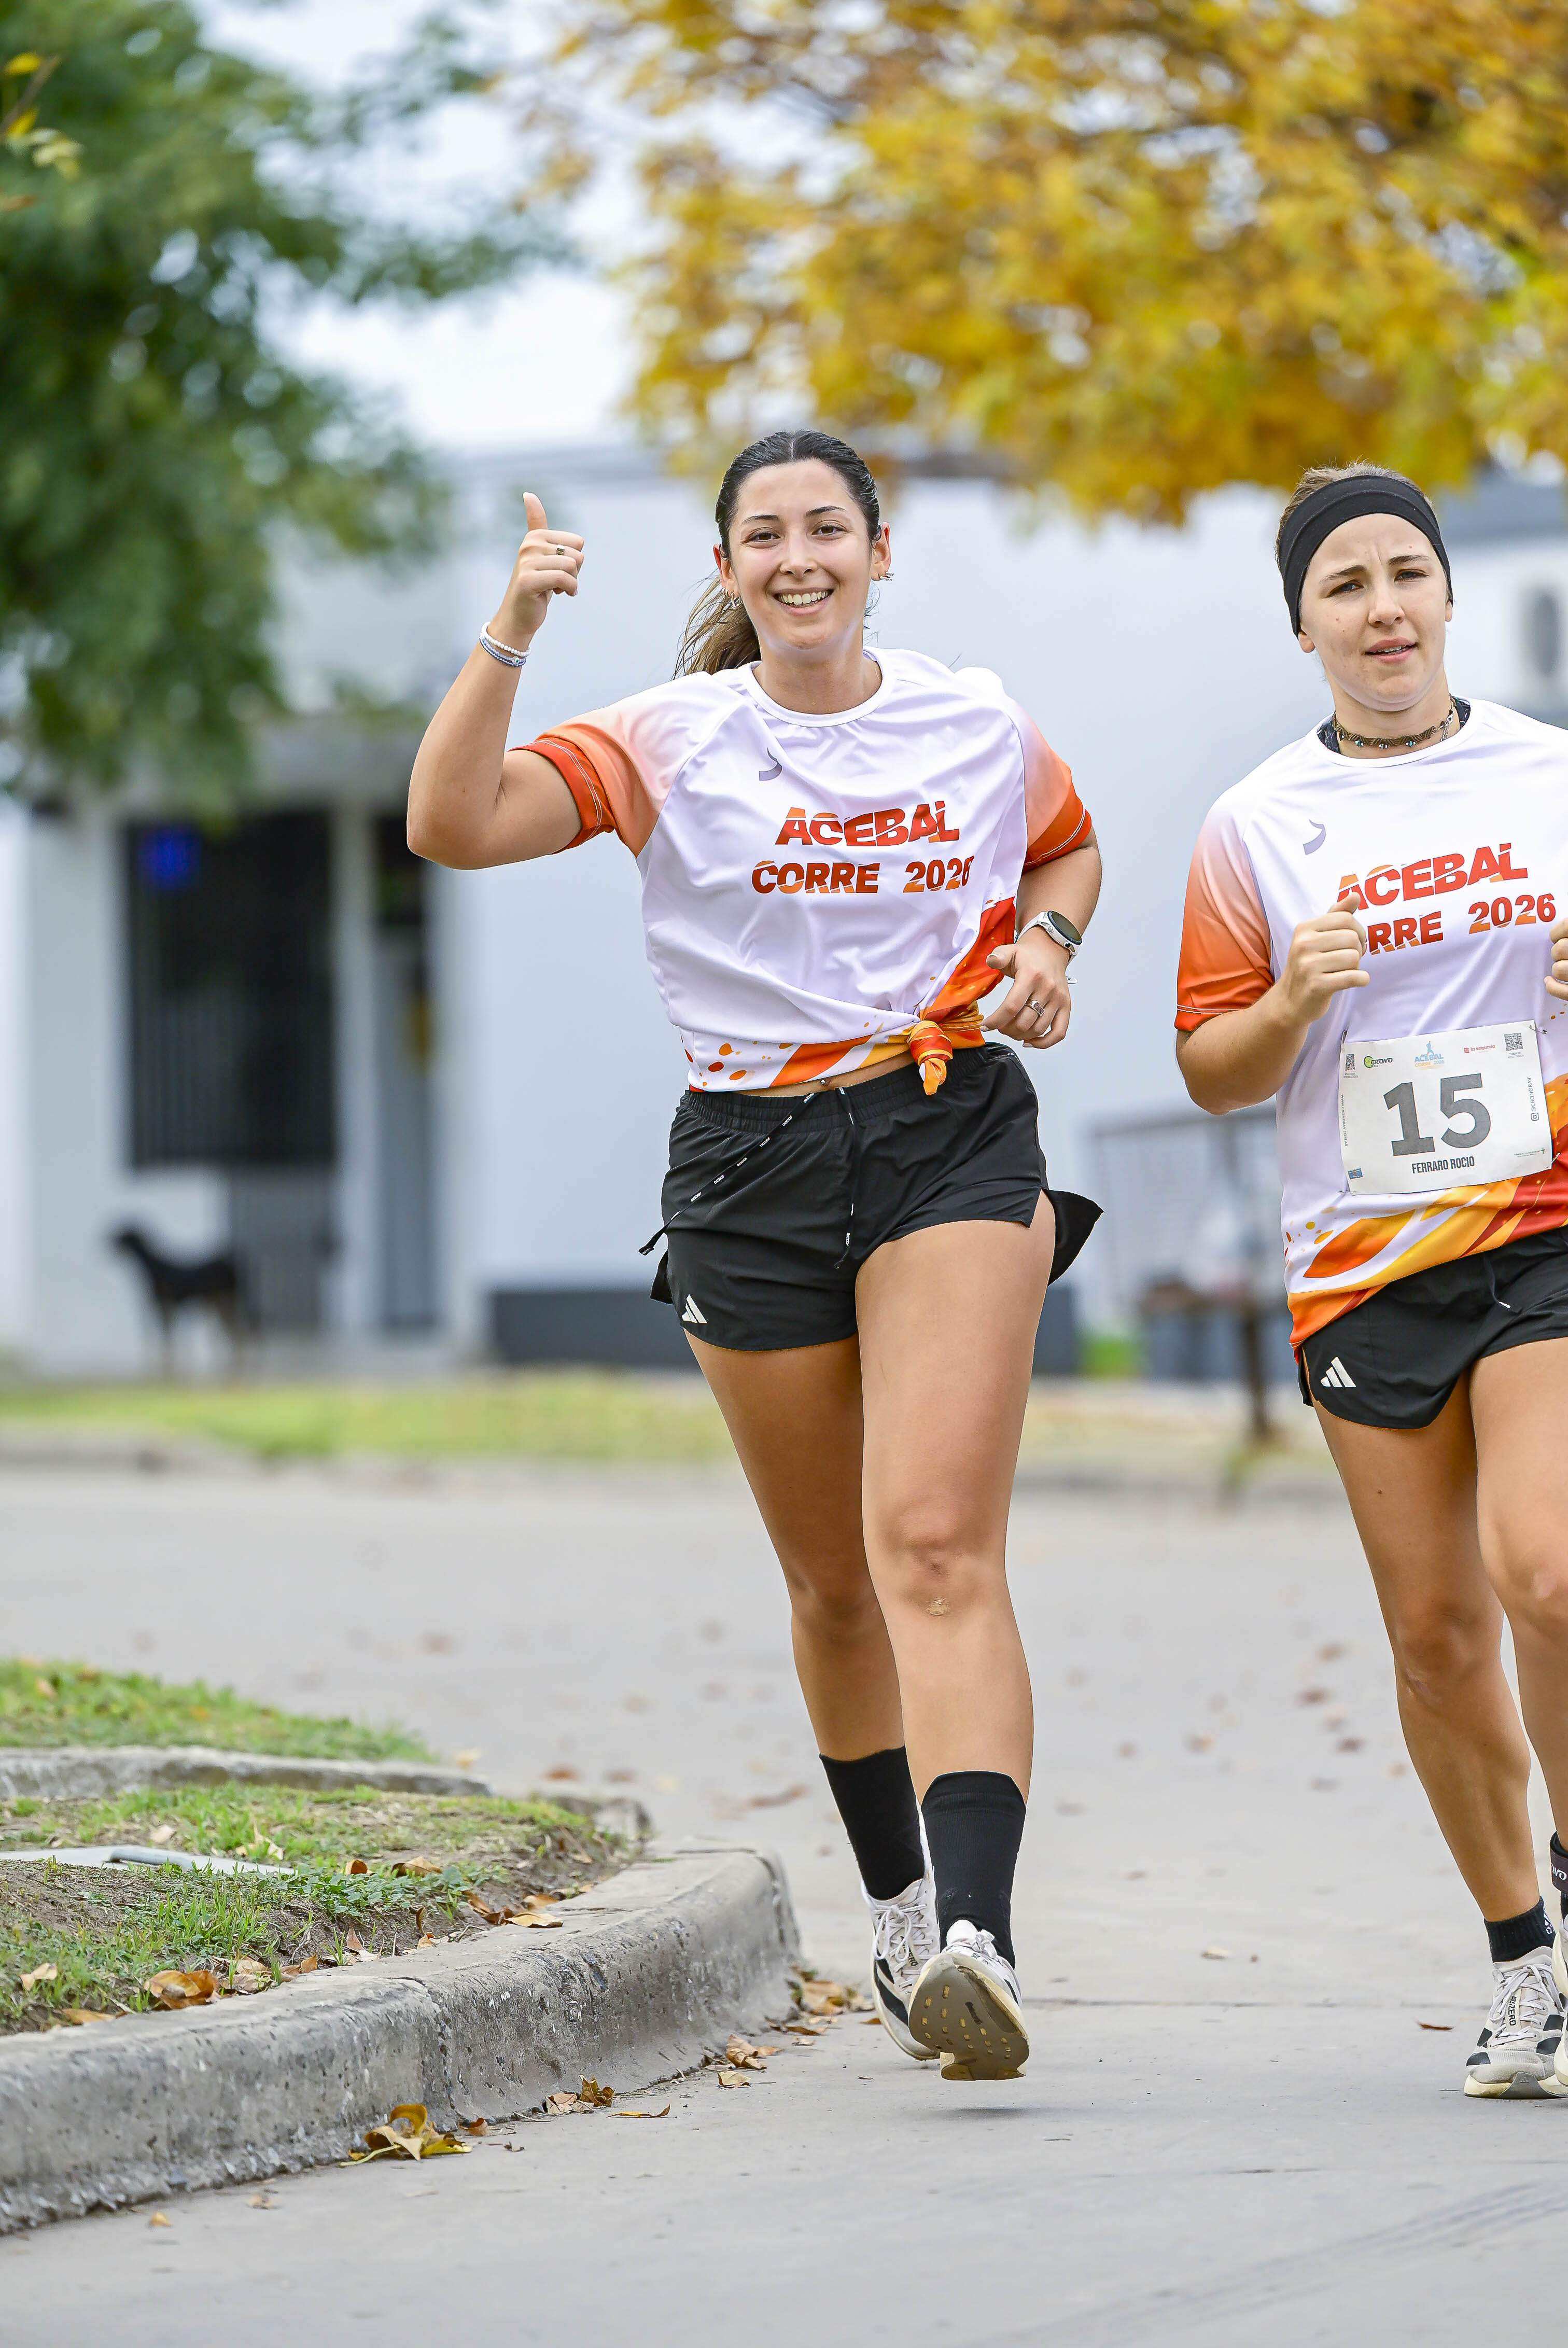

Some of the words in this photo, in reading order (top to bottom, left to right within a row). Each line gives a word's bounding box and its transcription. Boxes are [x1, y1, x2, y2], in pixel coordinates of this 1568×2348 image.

[775, 801, 960, 847] ACEBAL
[751, 860, 880, 894] CORRE
[902, 855, 975, 893] 2026
[1336, 843, 1528, 911] ACEBAL
[1365, 911, 1444, 956] RRE
[1468, 893, 1556, 935] 2026
[1383, 1073, 1491, 1157] 15
[1411, 1159, 1449, 1174] FERRARO
[1450, 1156, 1475, 1169] ROCIO
[1508, 1996, 1517, 2026] ADIZERO
